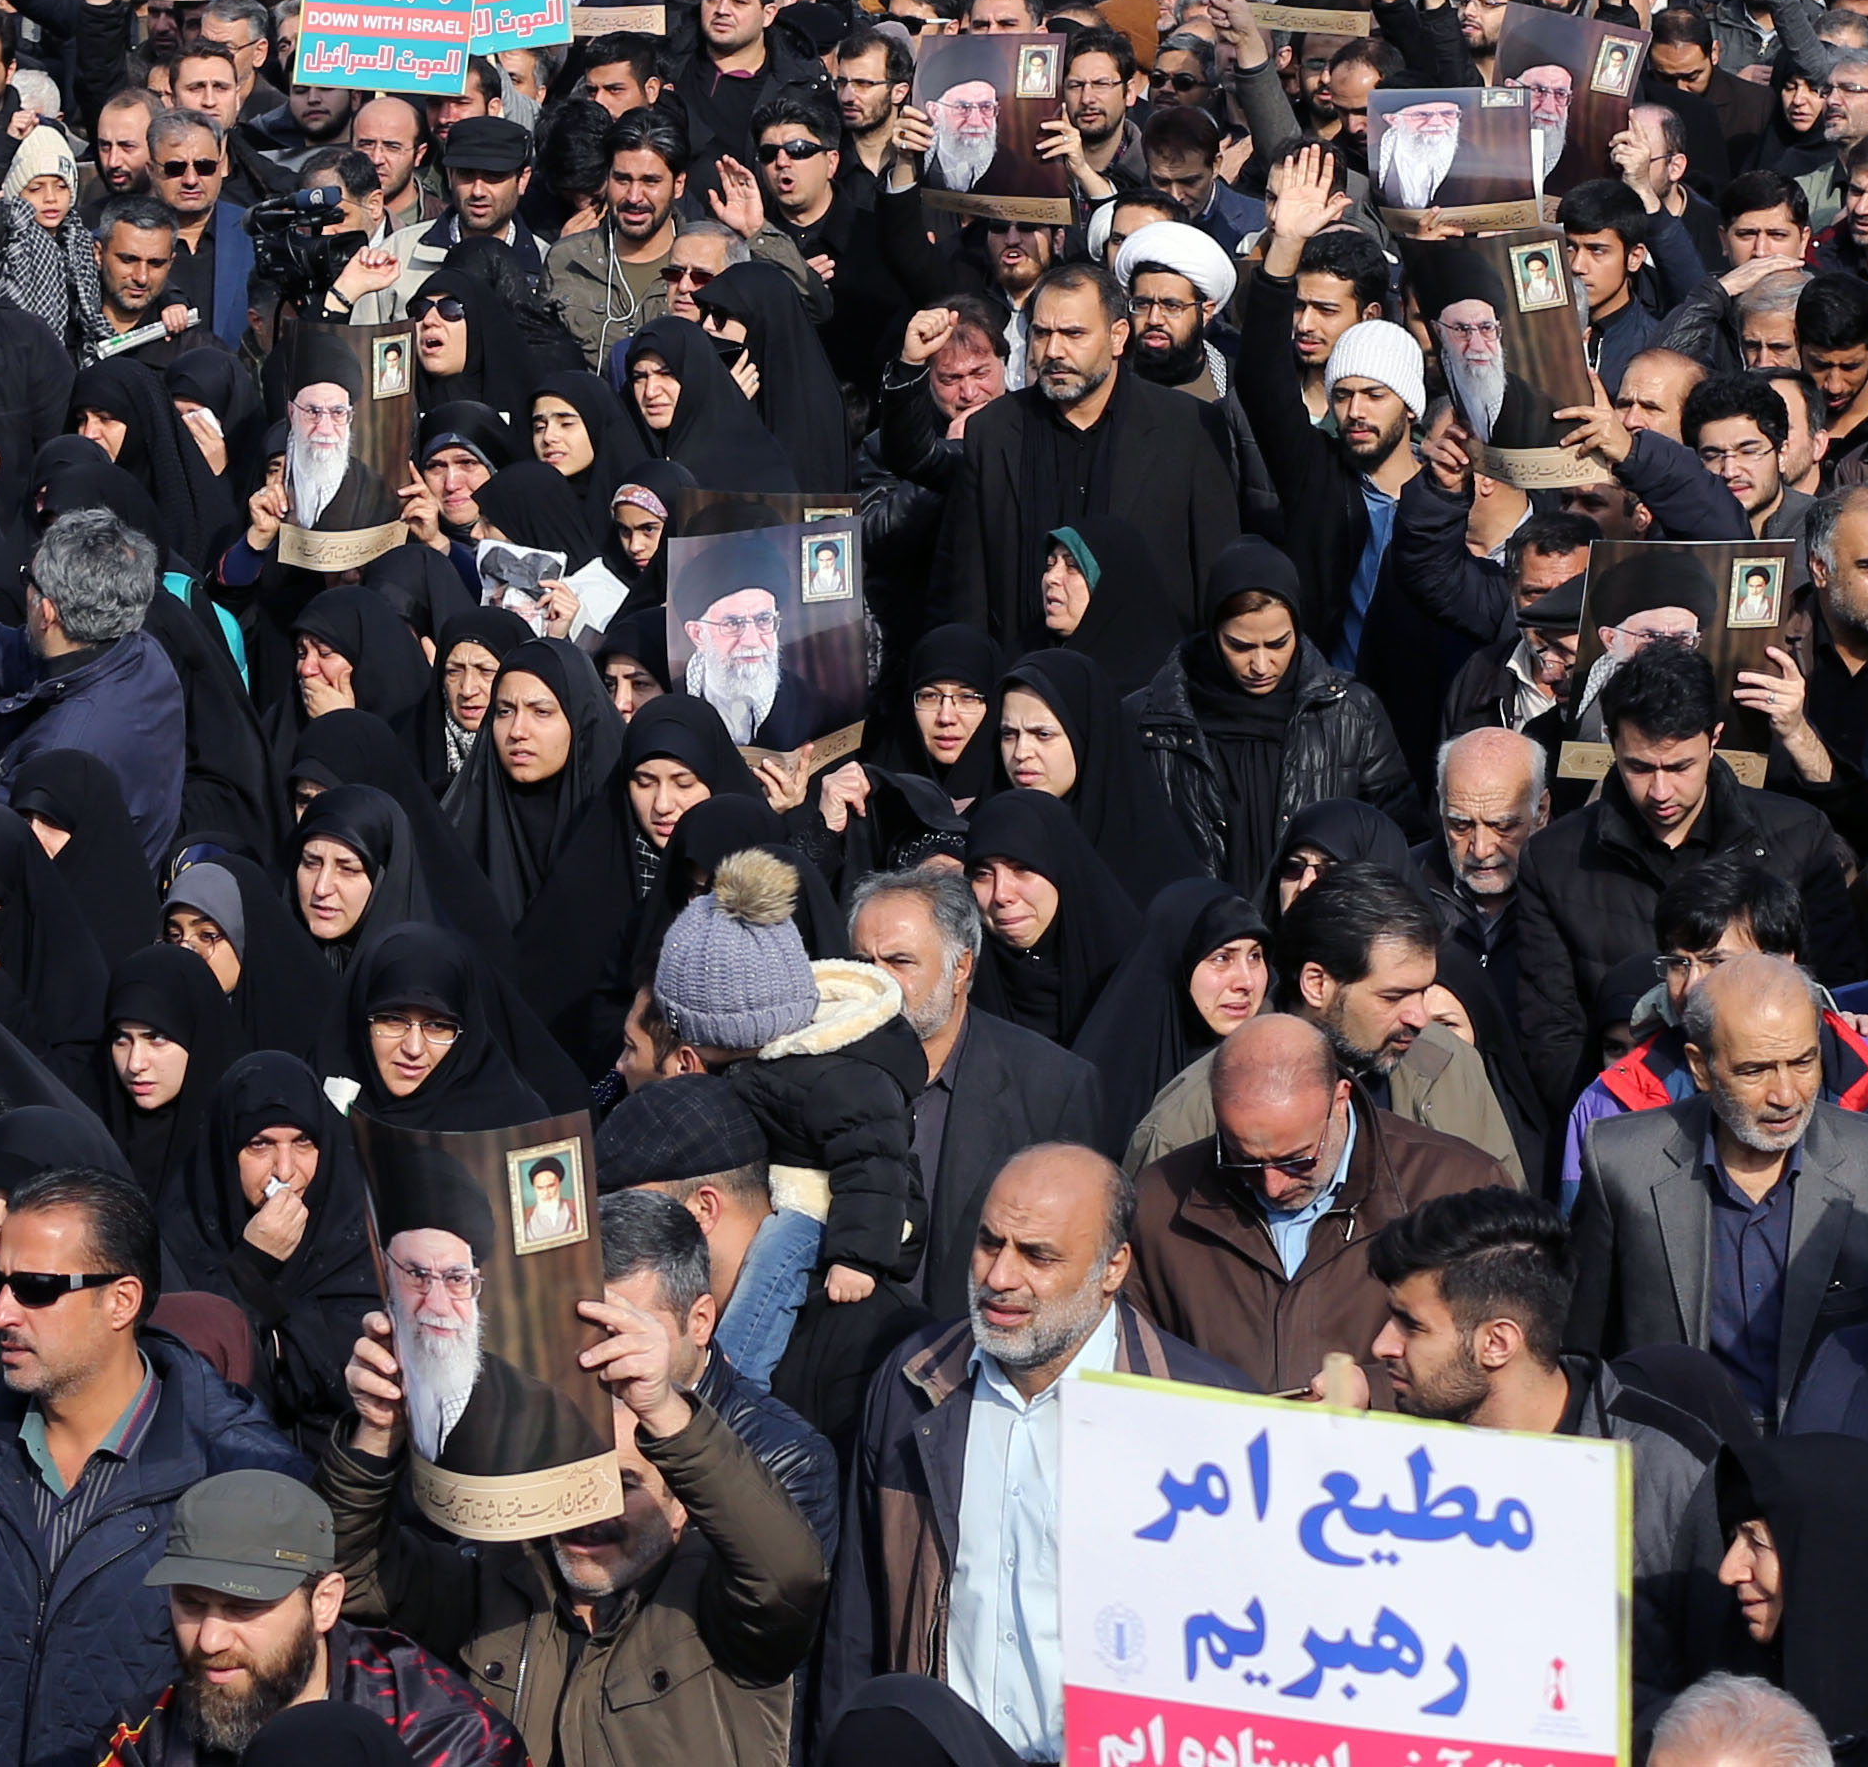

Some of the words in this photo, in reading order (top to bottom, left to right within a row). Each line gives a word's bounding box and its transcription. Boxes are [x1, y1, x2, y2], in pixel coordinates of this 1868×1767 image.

[304, 40, 393, 75] لاسرائیل
[307, 10, 359, 29] DOWN
[362, 15, 404, 31] WITH
[407, 18, 464, 35] ISRAEL
[395, 50, 461, 84] الموت
[1134, 1428, 1270, 1542] امر
[1298, 1446, 1534, 1567] مطیع
[1184, 1596, 1469, 1716] رهبریم
